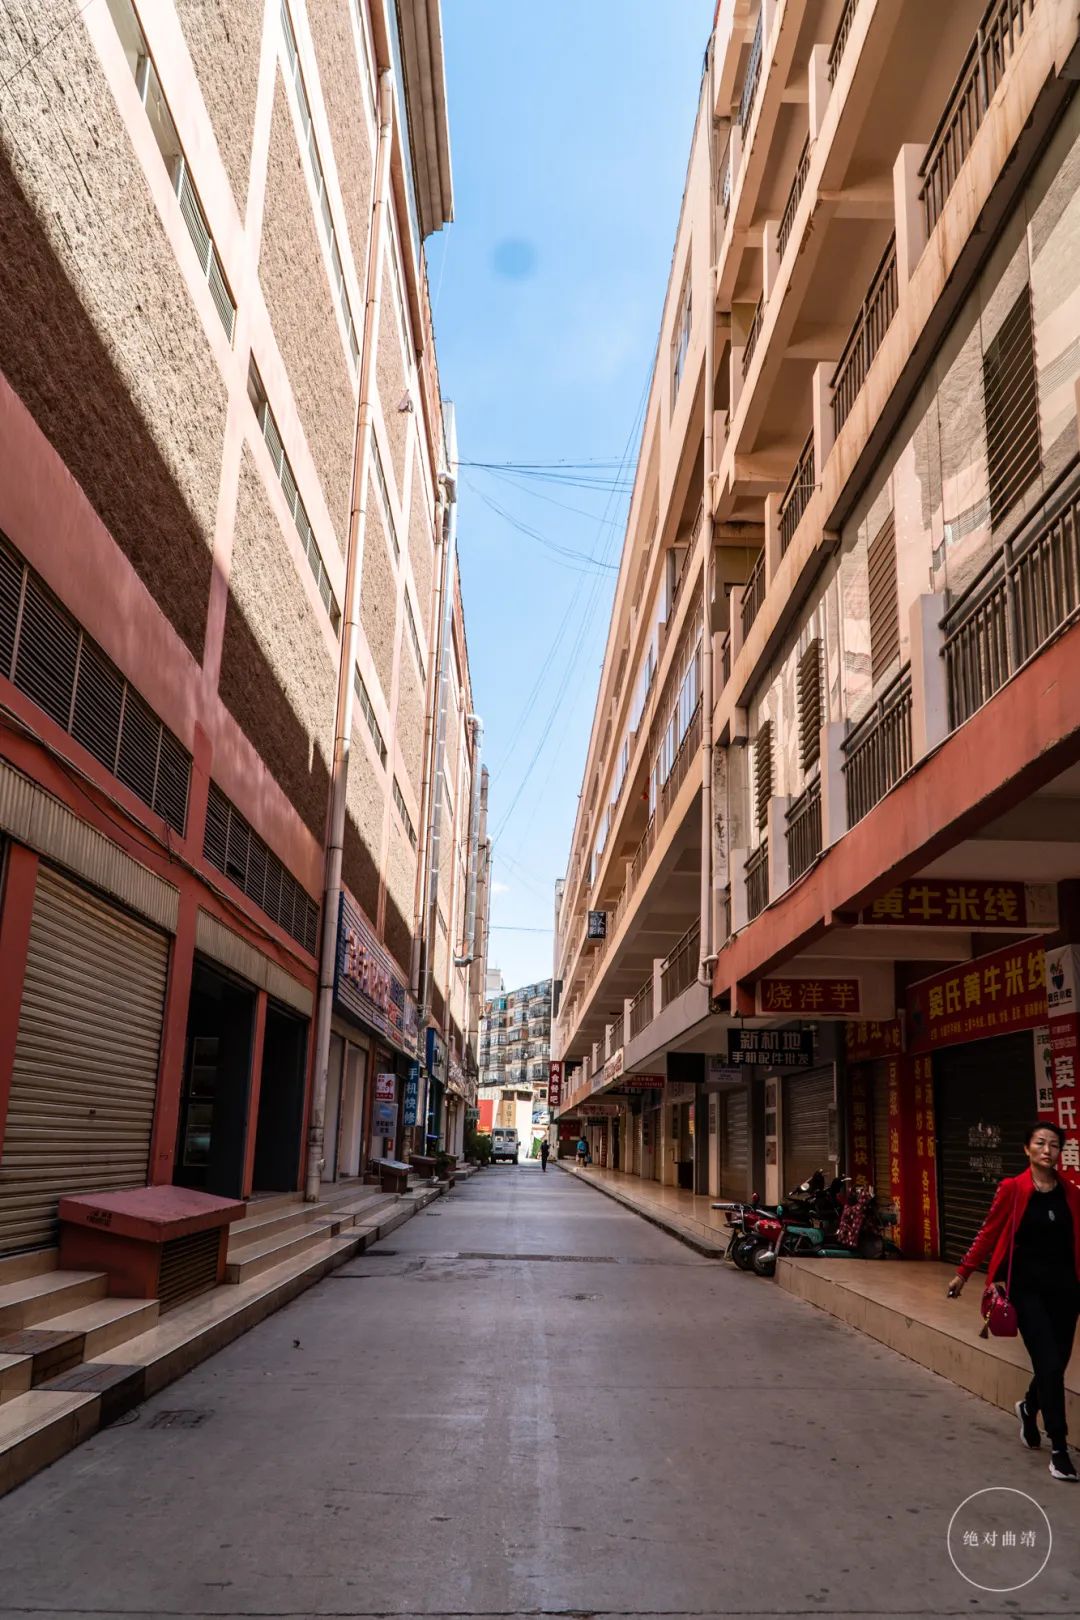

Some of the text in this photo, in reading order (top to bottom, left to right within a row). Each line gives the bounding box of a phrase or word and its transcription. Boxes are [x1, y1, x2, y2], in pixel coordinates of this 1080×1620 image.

[871, 885, 1018, 921] 黄牛米线
[766, 982, 856, 1009] 烧洋芋
[731, 1051, 809, 1065] 手机配件批发
[404, 1067, 418, 1125] 手机快修
[1054, 1056, 1080, 1190] 窦氏黄
